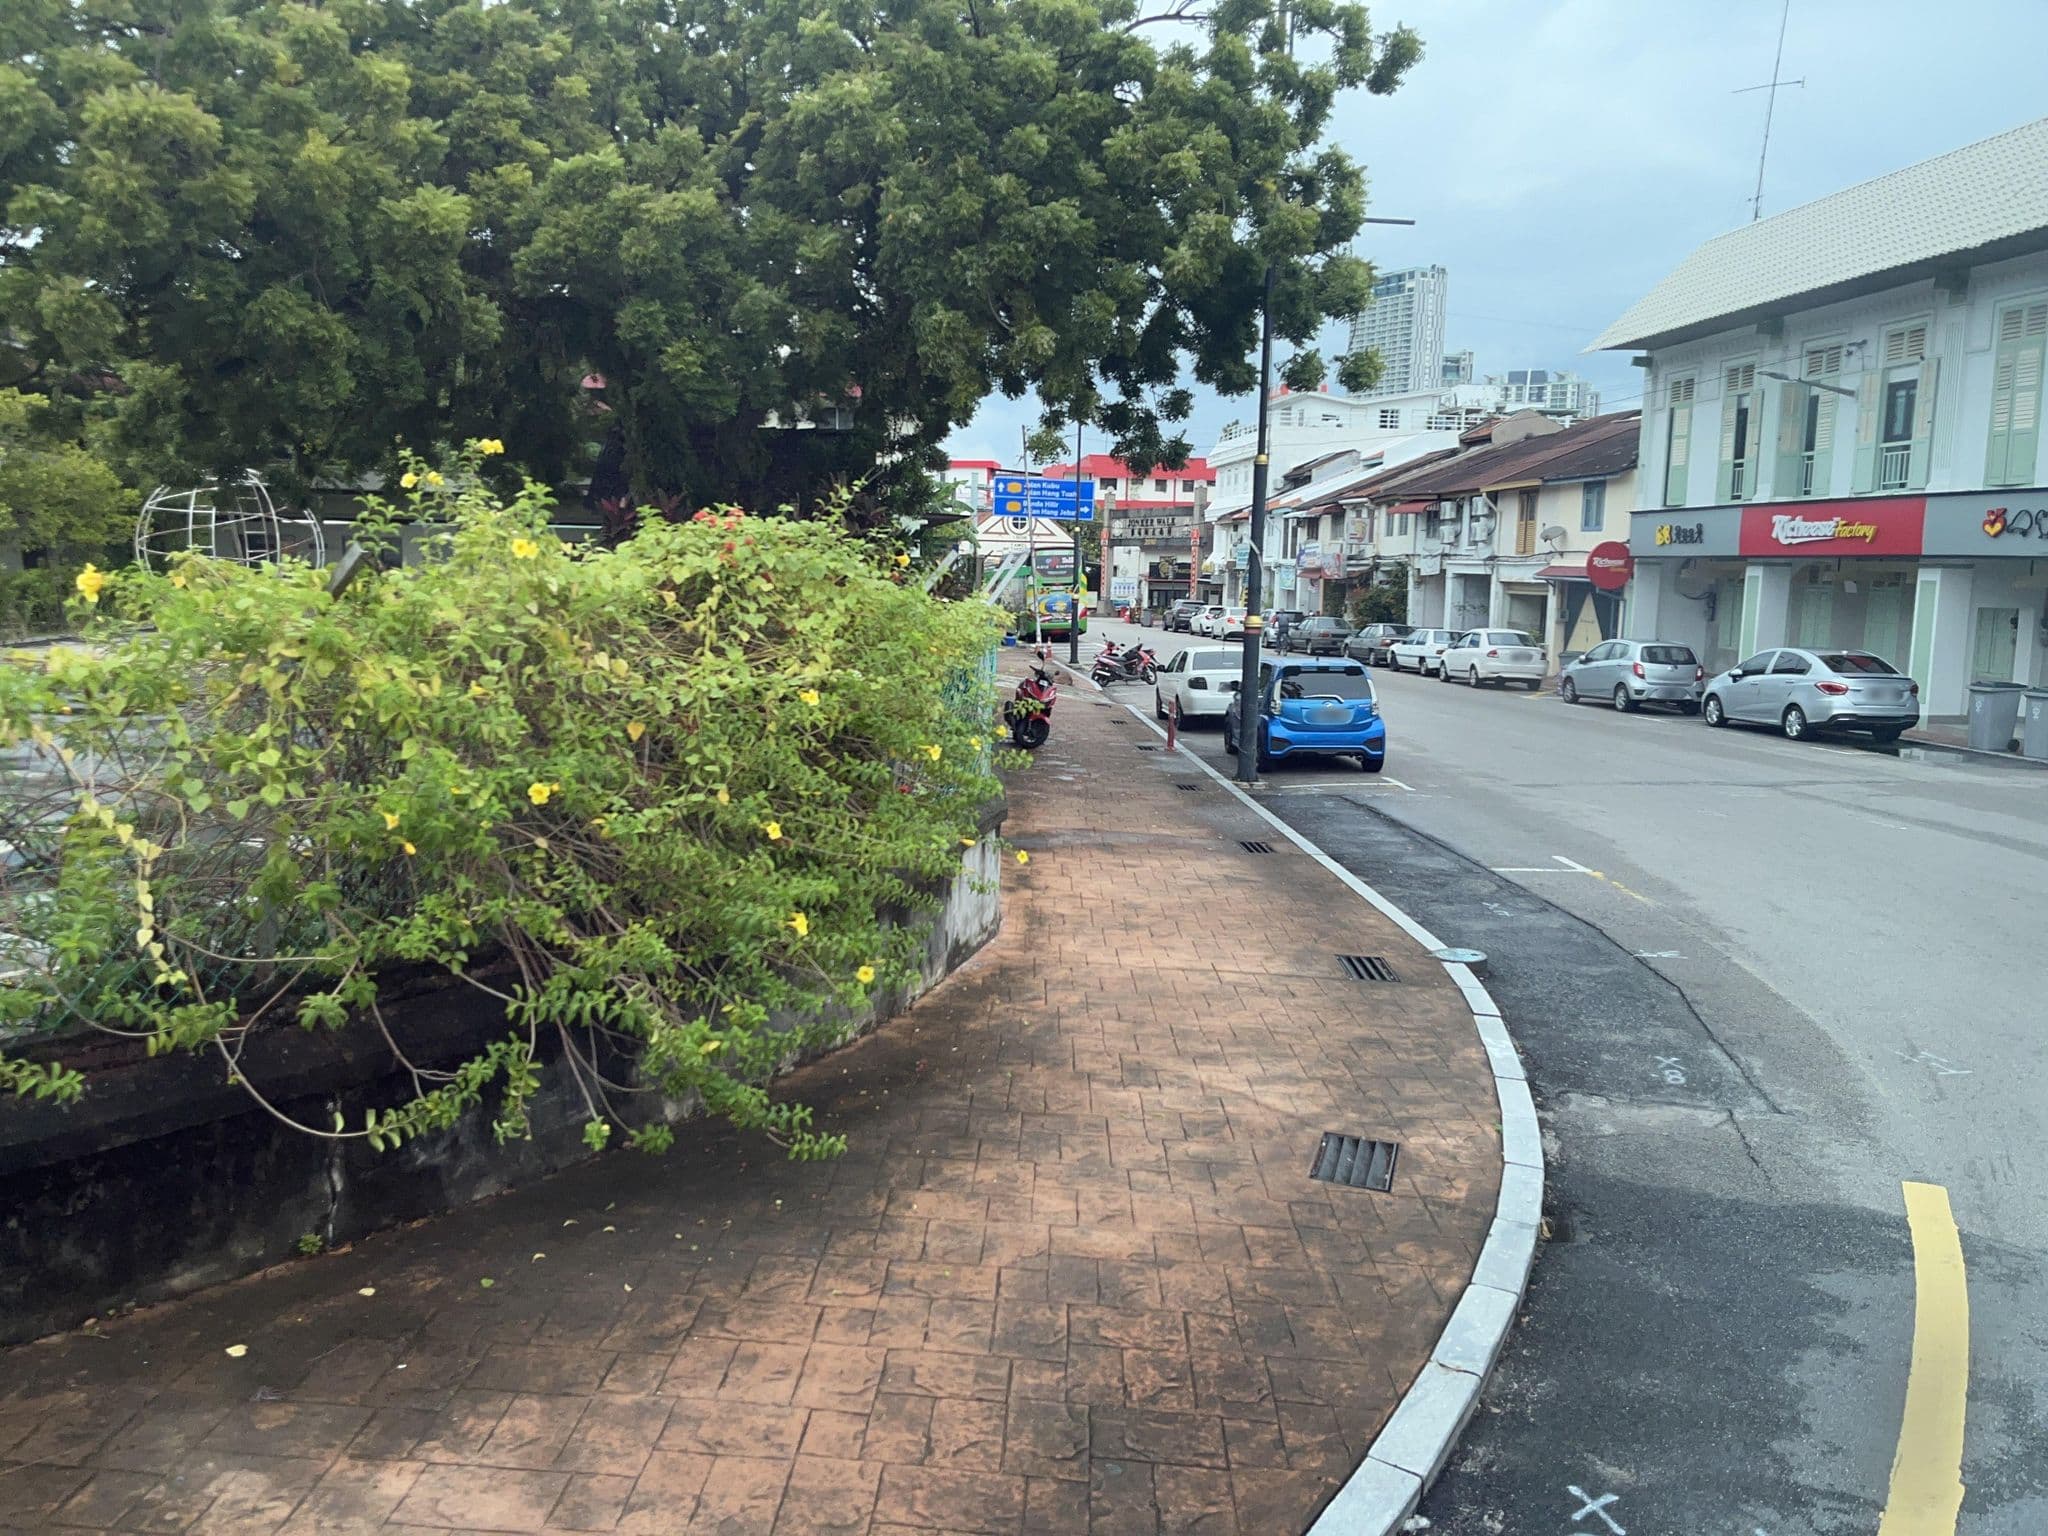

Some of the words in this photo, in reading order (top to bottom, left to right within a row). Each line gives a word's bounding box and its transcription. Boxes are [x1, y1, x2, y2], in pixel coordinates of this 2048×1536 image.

[1128, 518, 1154, 527] JONKER
[1156, 518, 1176, 526] WALK
[1771, 514, 1841, 545] Richeese
[1835, 519, 1878, 544] Factory
